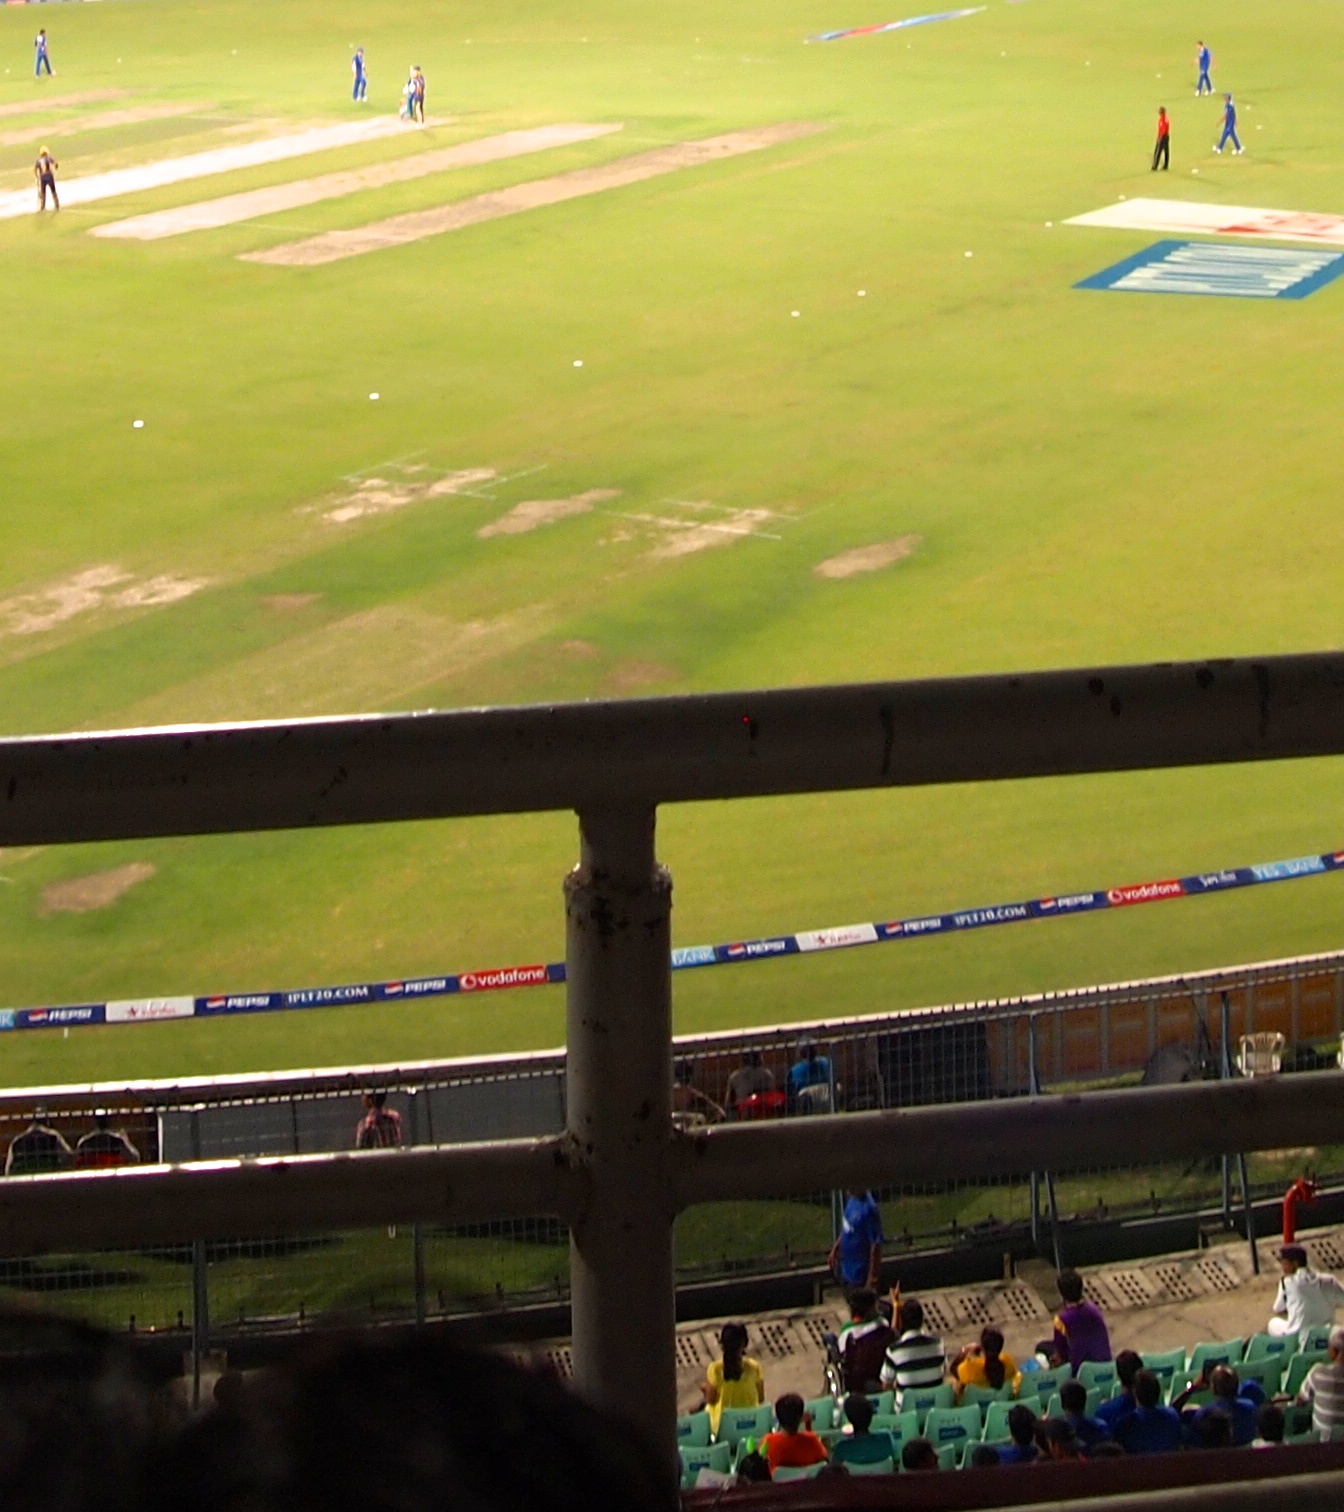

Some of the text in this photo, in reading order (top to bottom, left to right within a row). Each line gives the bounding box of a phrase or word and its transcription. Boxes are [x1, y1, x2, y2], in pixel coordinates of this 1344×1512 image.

[1058, 894, 1094, 908] PEPSI
[903, 919, 941, 932] PEPSI
[747, 941, 785, 954] PEPSI
[478, 969, 545, 986] vodafone
[402, 980, 446, 993] PEPSI
[227, 995, 270, 1008] PEPSI
[288, 987, 369, 1004] IPLT20.COM
[47, 1009, 92, 1021] PEPSI
